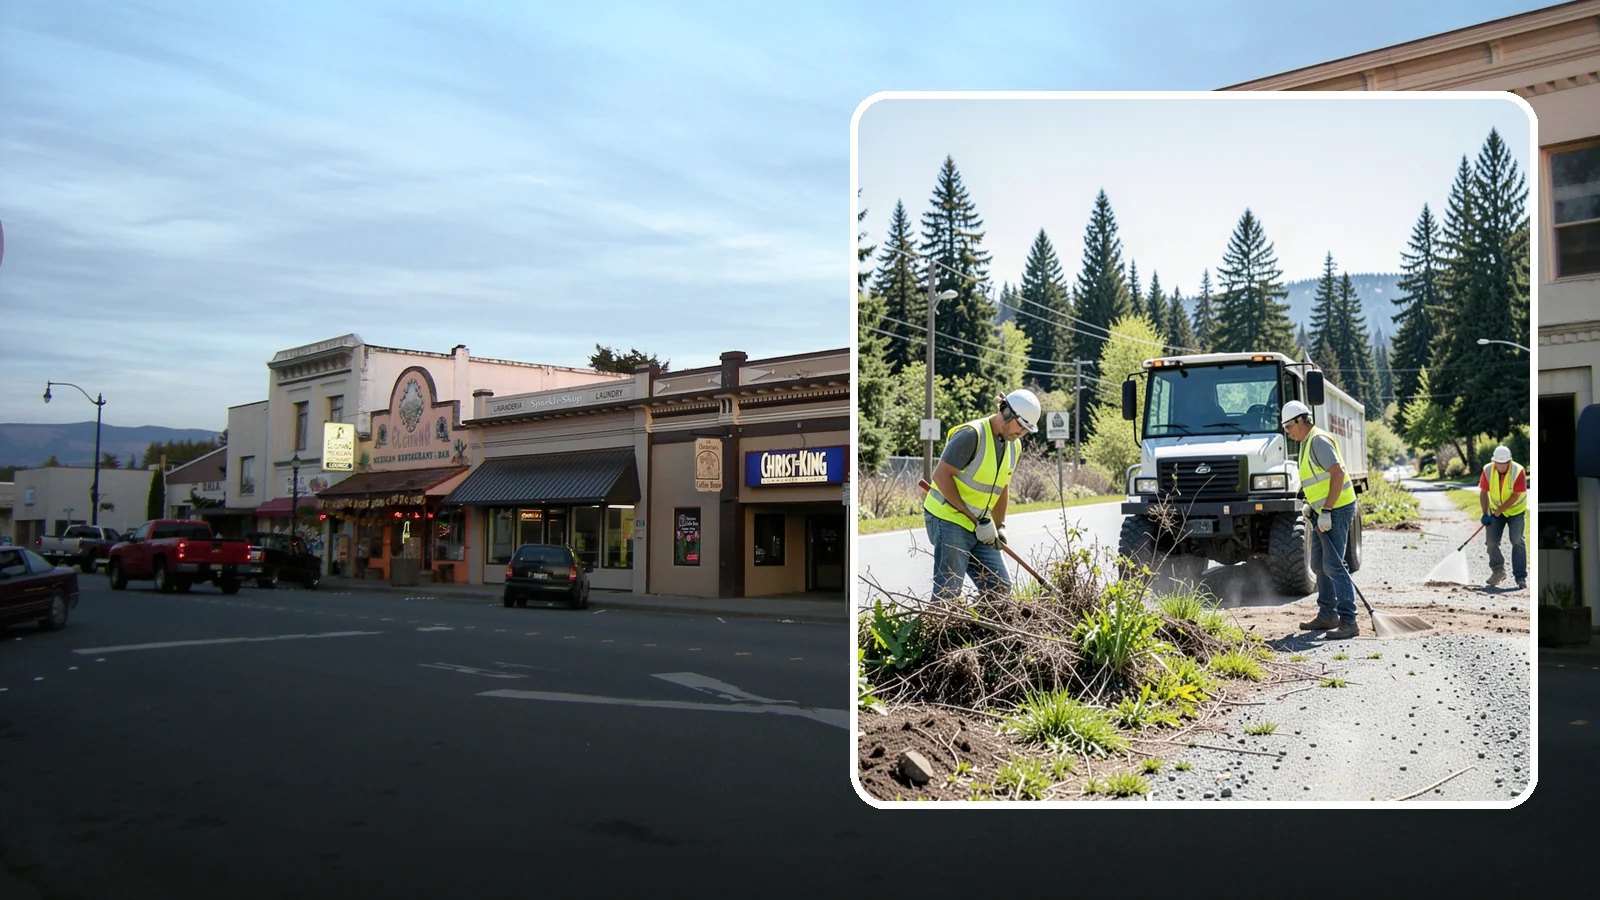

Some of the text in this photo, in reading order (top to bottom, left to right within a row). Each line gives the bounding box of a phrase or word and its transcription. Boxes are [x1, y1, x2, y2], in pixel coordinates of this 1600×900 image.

[493, 389, 623, 412] LAVANDERIA Sparkle Shop LAUNDRY
[373, 454, 396, 464] MEXICAN
[398, 451, 434, 462] RESTAURANT
[438, 450, 450, 459] BAR
[761, 450, 827, 479] CHRIST KING
[696, 481, 721, 489] Coffee House
